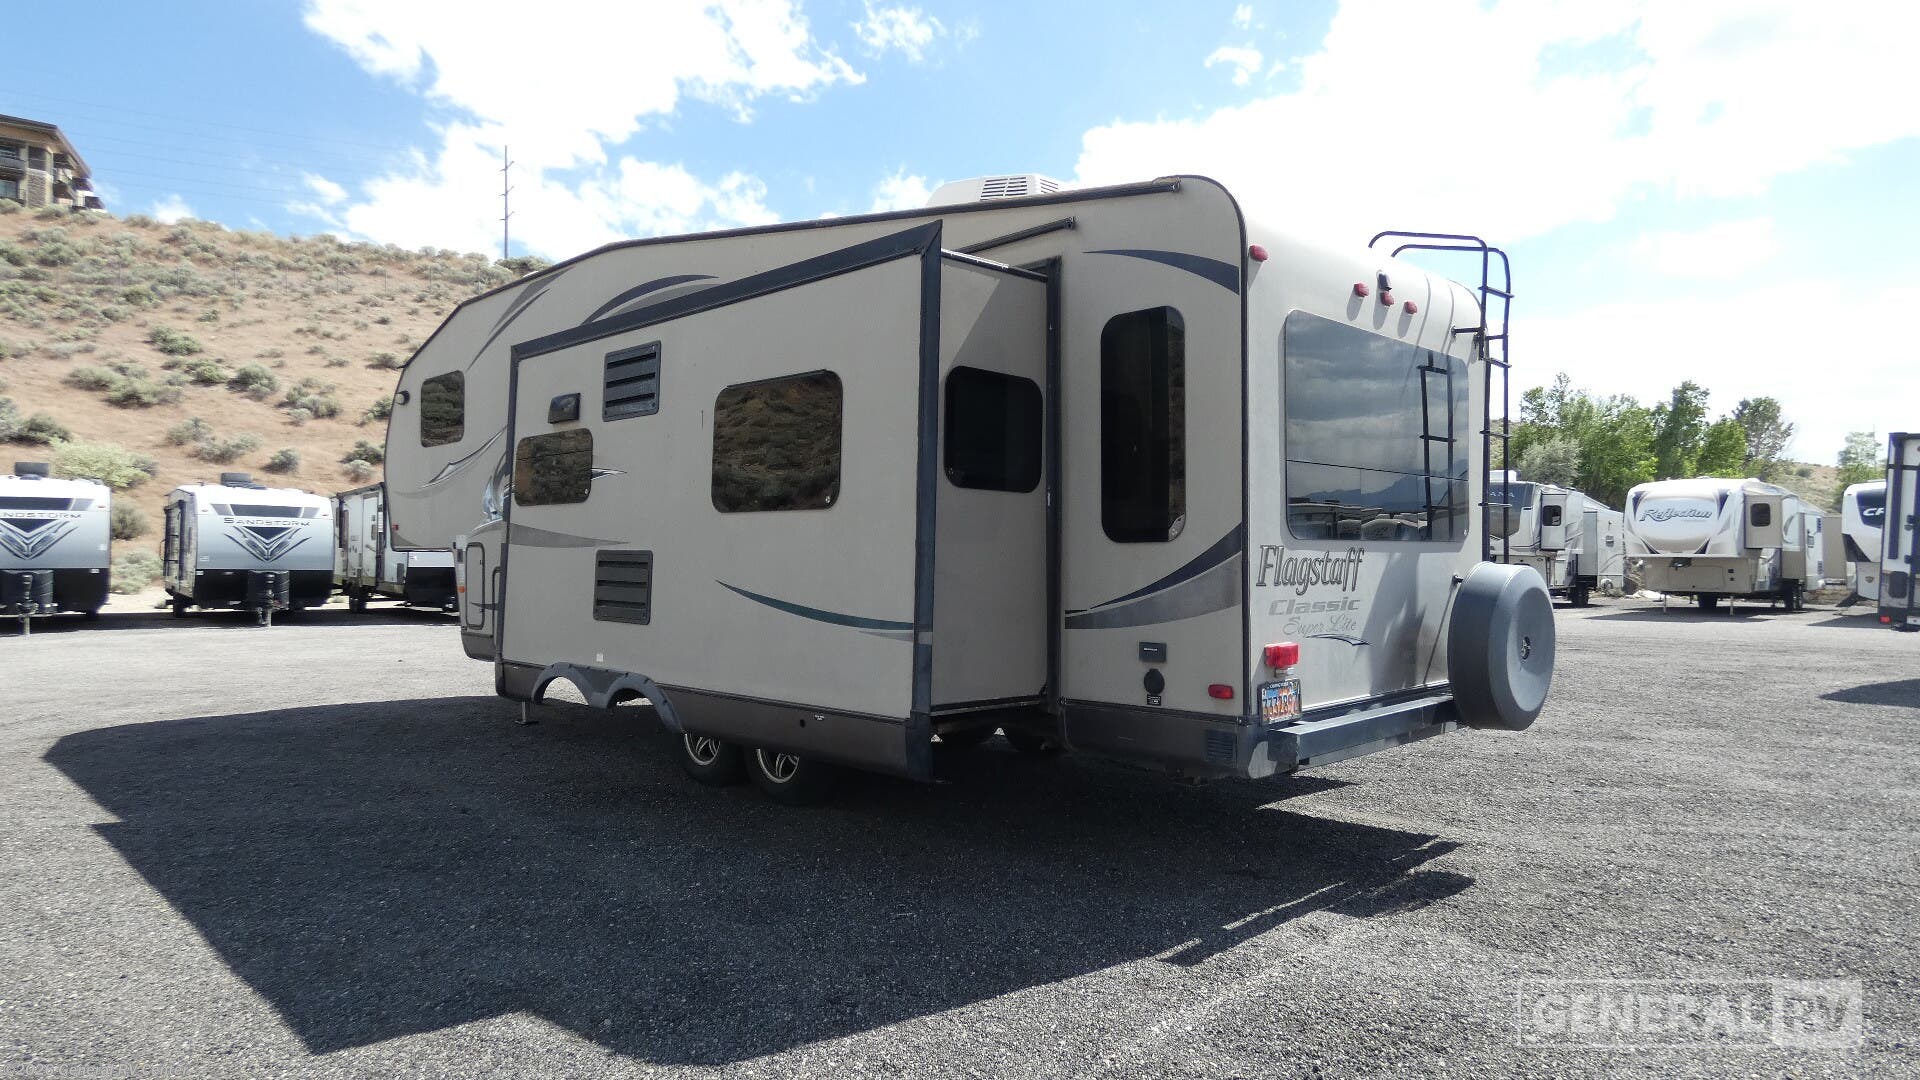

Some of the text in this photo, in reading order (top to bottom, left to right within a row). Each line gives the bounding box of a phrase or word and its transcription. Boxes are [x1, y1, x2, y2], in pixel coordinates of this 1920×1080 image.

[1639, 508, 1713, 522] Reflection
[1256, 544, 1365, 596] Flagstaff
[1268, 596, 1361, 616] Classic
[1282, 614, 1358, 637] Super Lite
